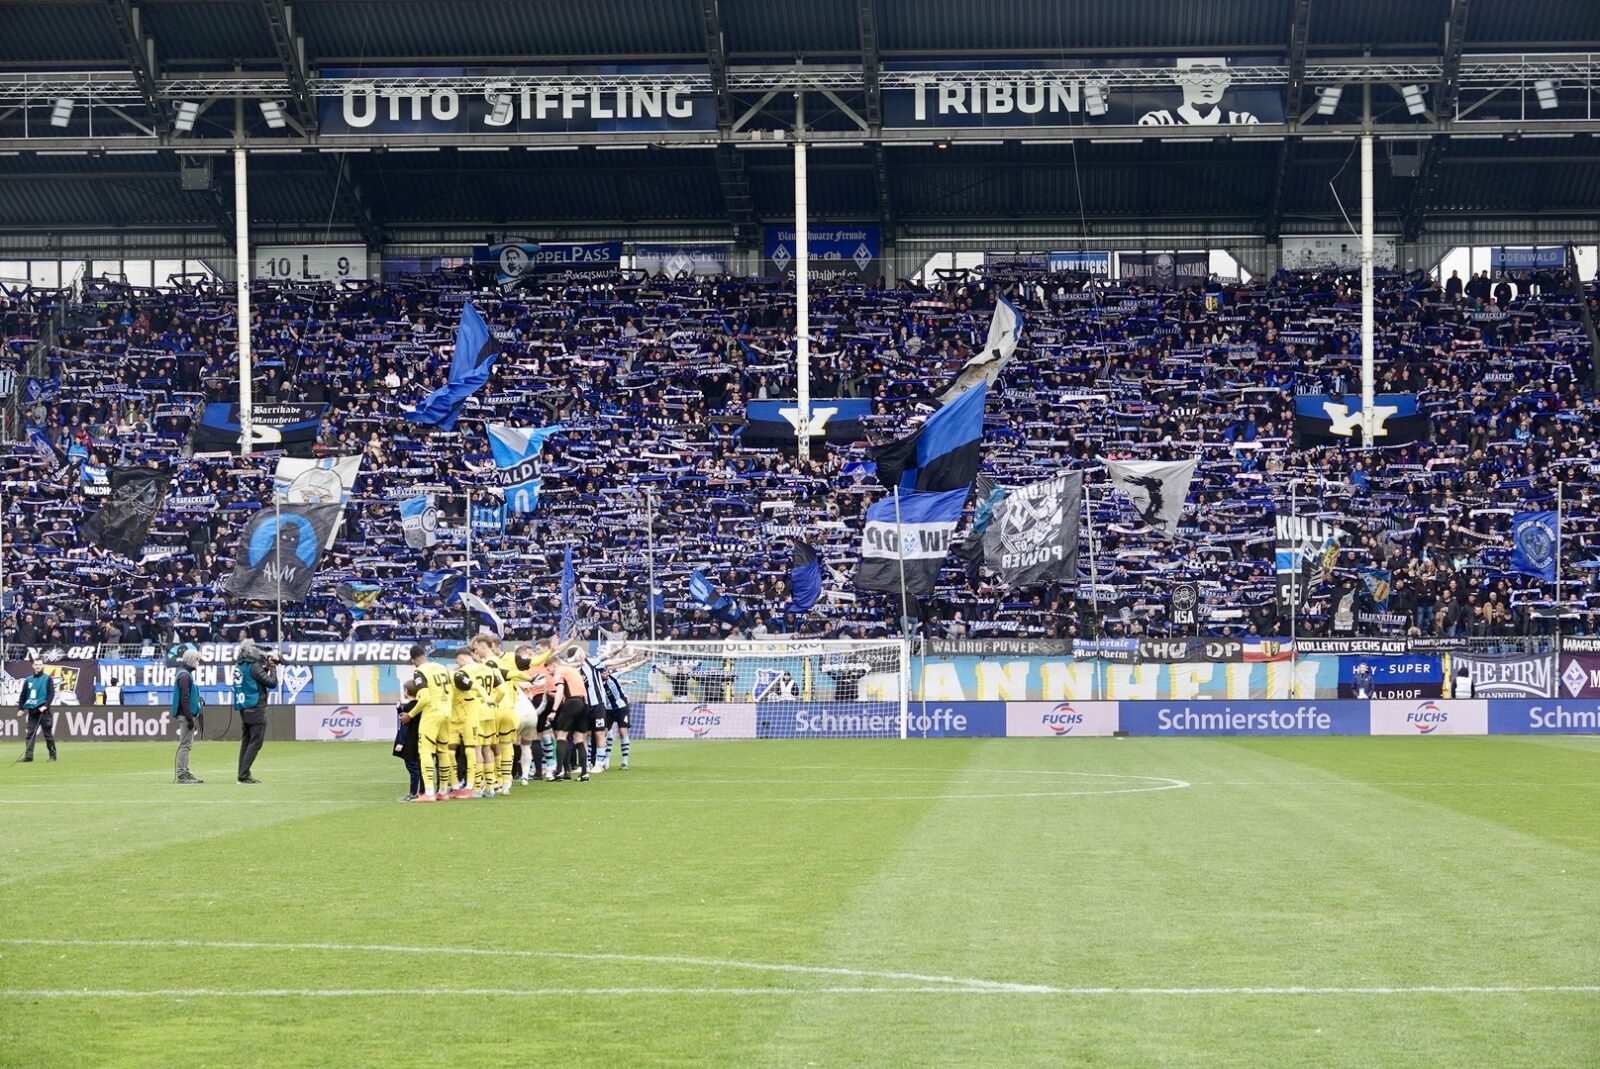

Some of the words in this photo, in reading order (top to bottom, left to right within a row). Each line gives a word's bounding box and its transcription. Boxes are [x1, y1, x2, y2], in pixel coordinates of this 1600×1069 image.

[1498, 251, 1558, 263] ODENWALD
[337, 256, 350, 276] 9
[1050, 260, 1108, 274] KAPUTTICKS
[1176, 261, 1208, 277] BASTARDS
[253, 405, 301, 414] Barrikade
[252, 416, 300, 424] Mannheim
[1173, 610, 1195, 624] KSA
[1358, 612, 1407, 624] LILIENKILLER
[282, 643, 347, 661] JEDEN
[352, 643, 412, 661] PREIS
[932, 640, 1037, 654] WALDHOF-POWER
[1206, 642, 1241, 658] DP
[1300, 641, 1350, 651] KOLLEKTIV
[1351, 641, 1380, 651] SECHS
[1382, 641, 1406, 652] ACHT
[1073, 649, 1129, 659] Mannheim
[100, 664, 136, 687] NUR
[143, 661, 177, 687] FÜR
[194, 664, 217, 686] EN
[1353, 665, 1377, 675] HY
[1389, 663, 1430, 675] SUPER
[1452, 656, 1497, 687] THE
[1499, 655, 1553, 689] FIRM
[1371, 689, 1422, 699] ALDHOF
[321, 717, 362, 728] FUCHS
[595, 718, 605, 728] 29
[680, 716, 721, 726] FUCHS
[796, 708, 968, 731] Schmierstoffe
[1042, 714, 1083, 724] FUCHS
[1157, 706, 1331, 730] Schmierstoffe
[1407, 712, 1448, 722] FUCHS
[65, 711, 170, 737] Waldhof
